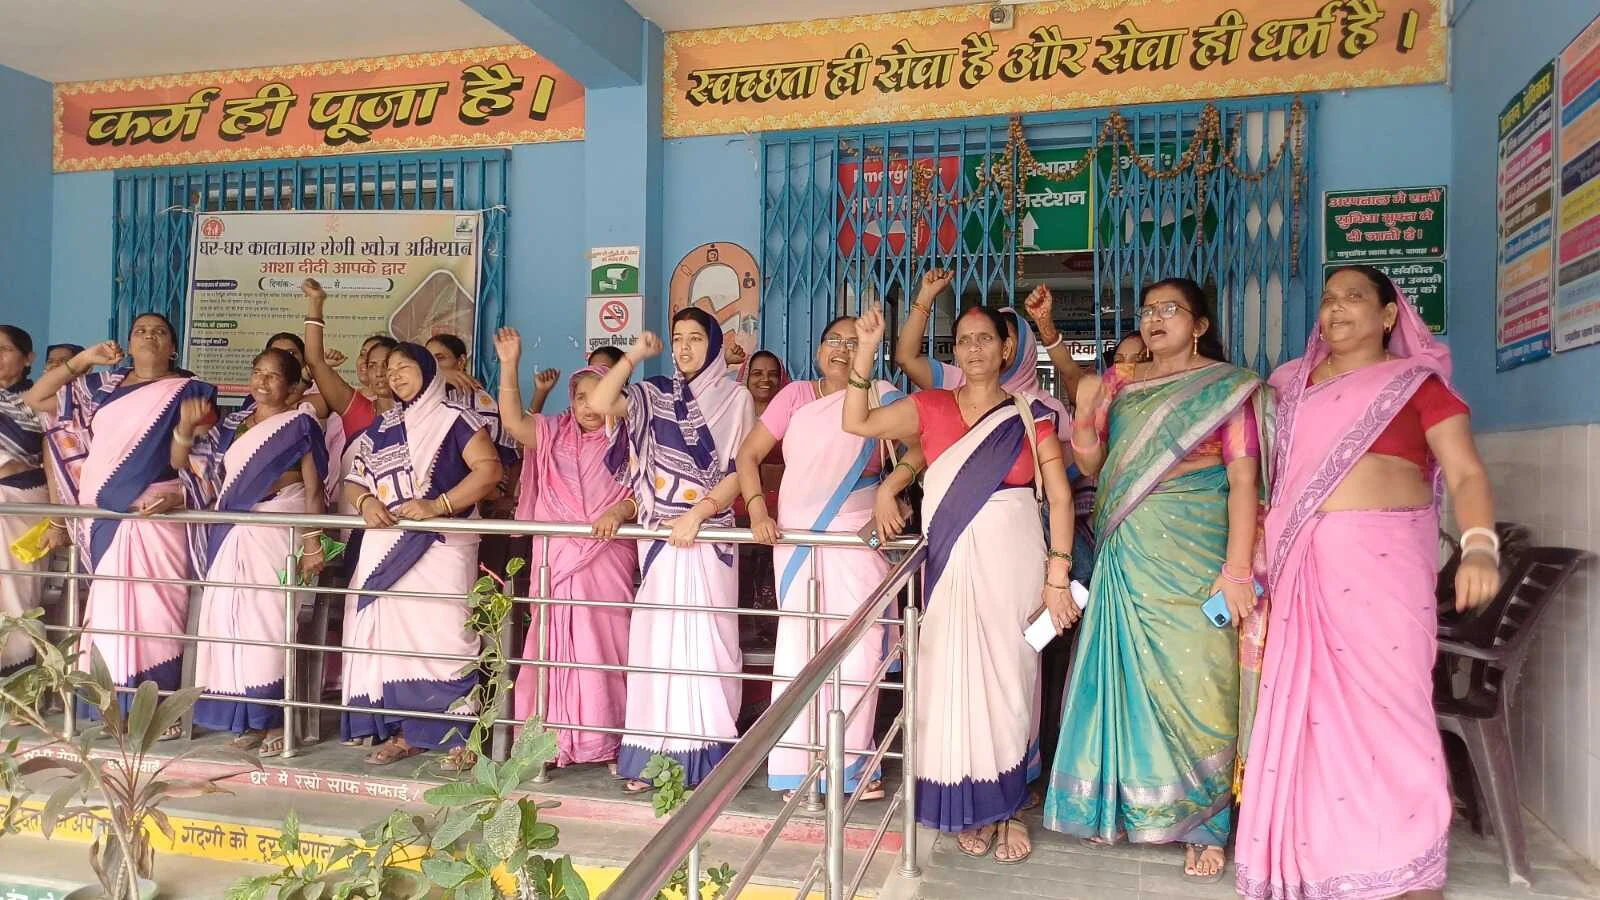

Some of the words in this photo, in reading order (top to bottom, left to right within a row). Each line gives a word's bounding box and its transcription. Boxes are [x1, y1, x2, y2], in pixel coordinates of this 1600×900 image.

[686, 59, 825, 106] स्वच्छता
[824, 39, 873, 100] ही
[873, 39, 959, 93] सेवा
[959, 30, 999, 86] है
[1000, 26, 1092, 82] और
[1092, 18, 1189, 74] सेवा
[1189, 9, 1248, 70] ही
[1249, 0, 1338, 65] धर्म
[1338, 0, 1385, 60] है
[86, 87, 221, 145] कर्म
[218, 82, 297, 142] ही
[308, 80, 450, 146] पूजा
[458, 63, 524, 123] है
[199, 241, 243, 256] घर-घर
[247, 241, 316, 256] कालाजार
[320, 236, 355, 256] रोगी
[360, 236, 400, 256] खोज
[405, 236, 473, 257] अभियान
[259, 261, 295, 274] आशा
[298, 258, 329, 274] दीदी
[332, 259, 378, 275] आपके
[381, 262, 408, 276] द्वार
[327, 777, 360, 795] साफ
[181, 822, 226, 850] गंदगी
[229, 829, 248, 850] को
